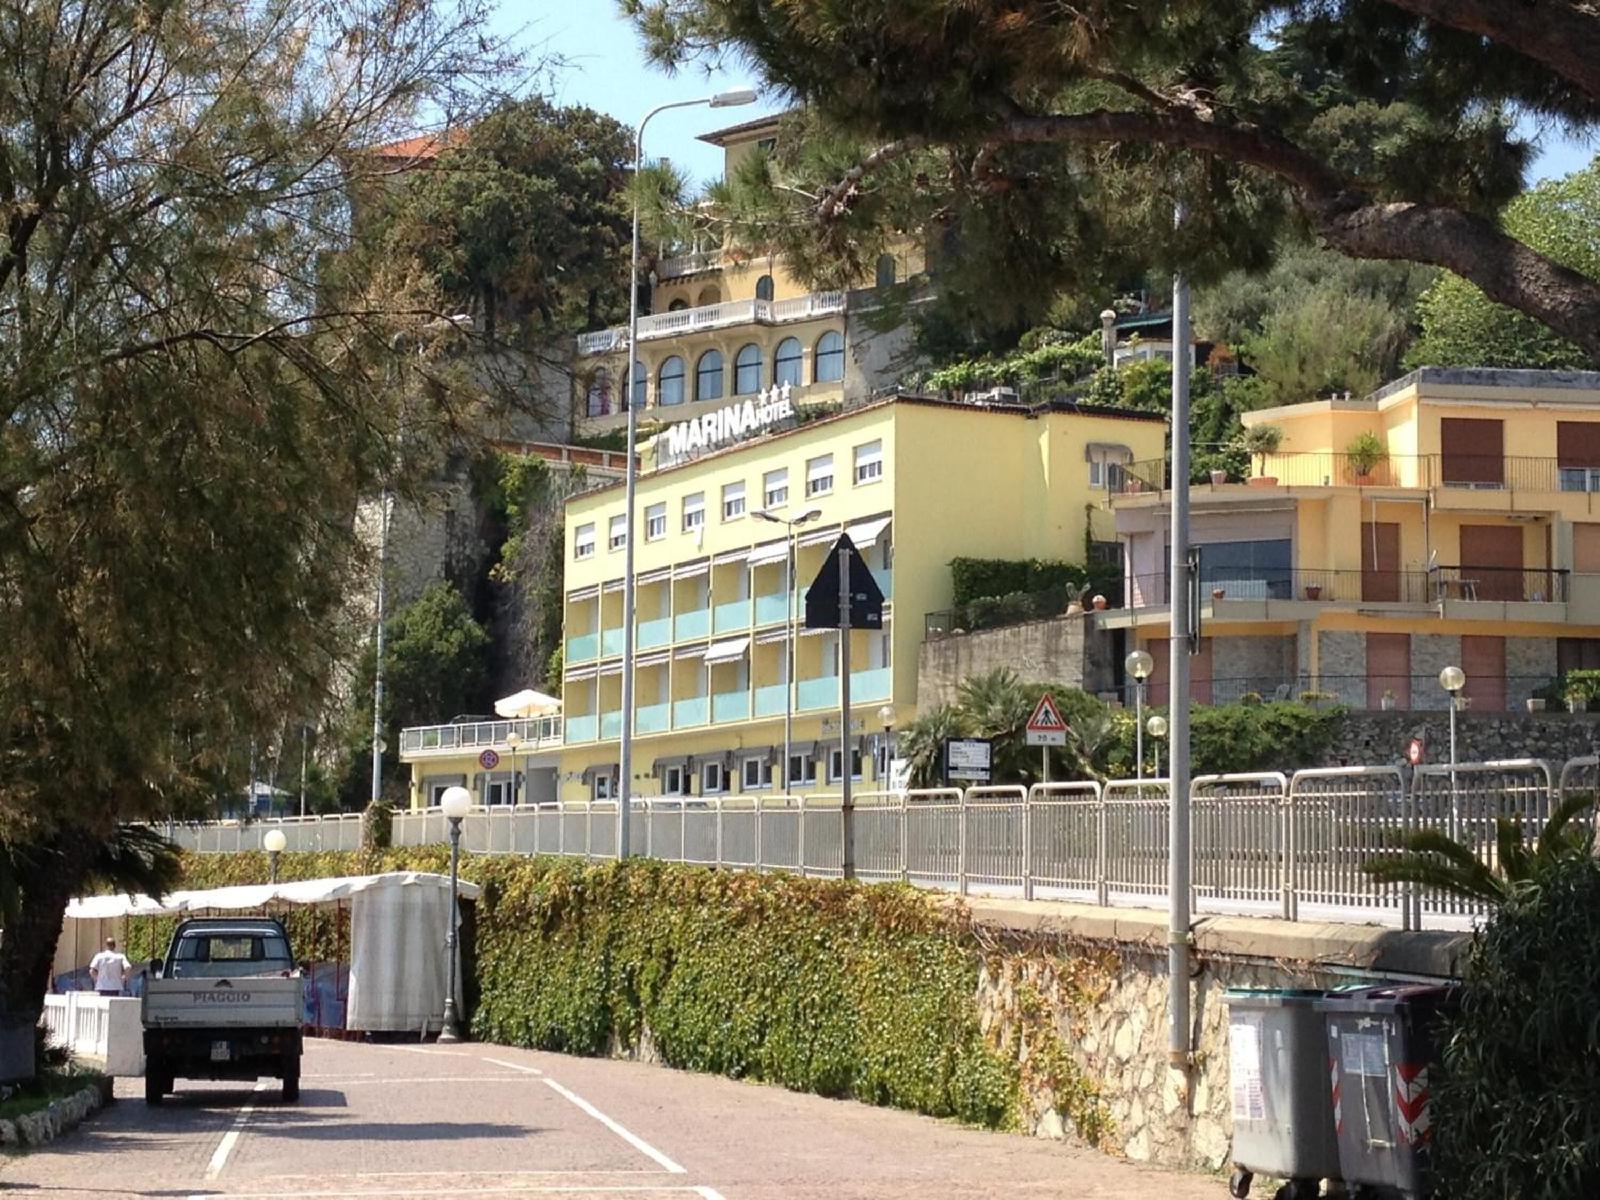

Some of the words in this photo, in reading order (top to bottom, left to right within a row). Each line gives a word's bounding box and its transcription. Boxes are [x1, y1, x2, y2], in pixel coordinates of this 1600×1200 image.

[667, 400, 756, 455] MARINA
[756, 399, 794, 424] HOTEL
[193, 991, 251, 1003] PIAGGIO
